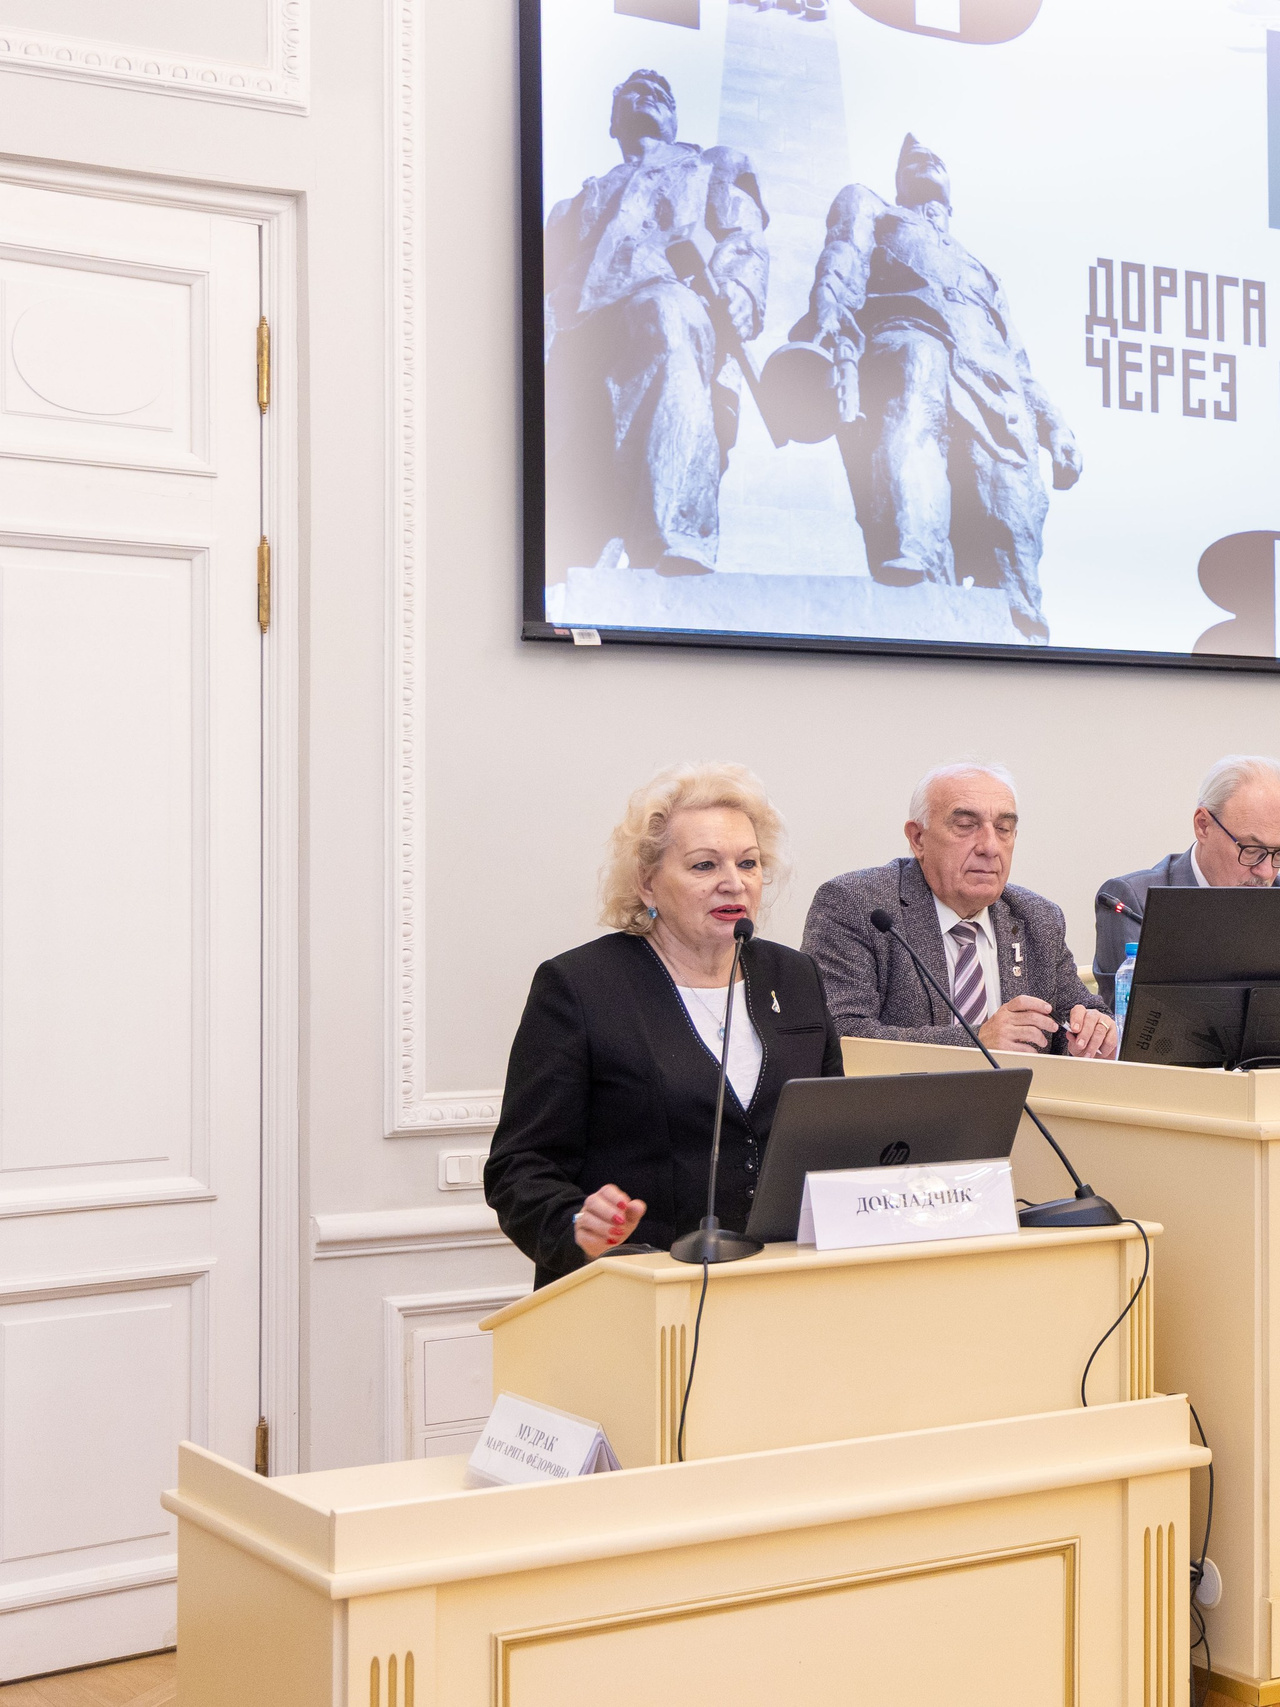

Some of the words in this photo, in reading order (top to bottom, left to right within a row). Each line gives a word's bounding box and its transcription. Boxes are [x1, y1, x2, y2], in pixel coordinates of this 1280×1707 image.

[1085, 257, 1267, 348] ДОРОГА
[1085, 336, 1238, 422] ЧЕРЕЗ
[882, 1141, 909, 1165] hp
[856, 1187, 973, 1216] ДОКЛАДЧИК
[515, 1423, 559, 1452] МУДРАК
[484, 1435, 526, 1463] МАРГАРИТА
[526, 1453, 570, 1478] ФЁДОРОВНА
